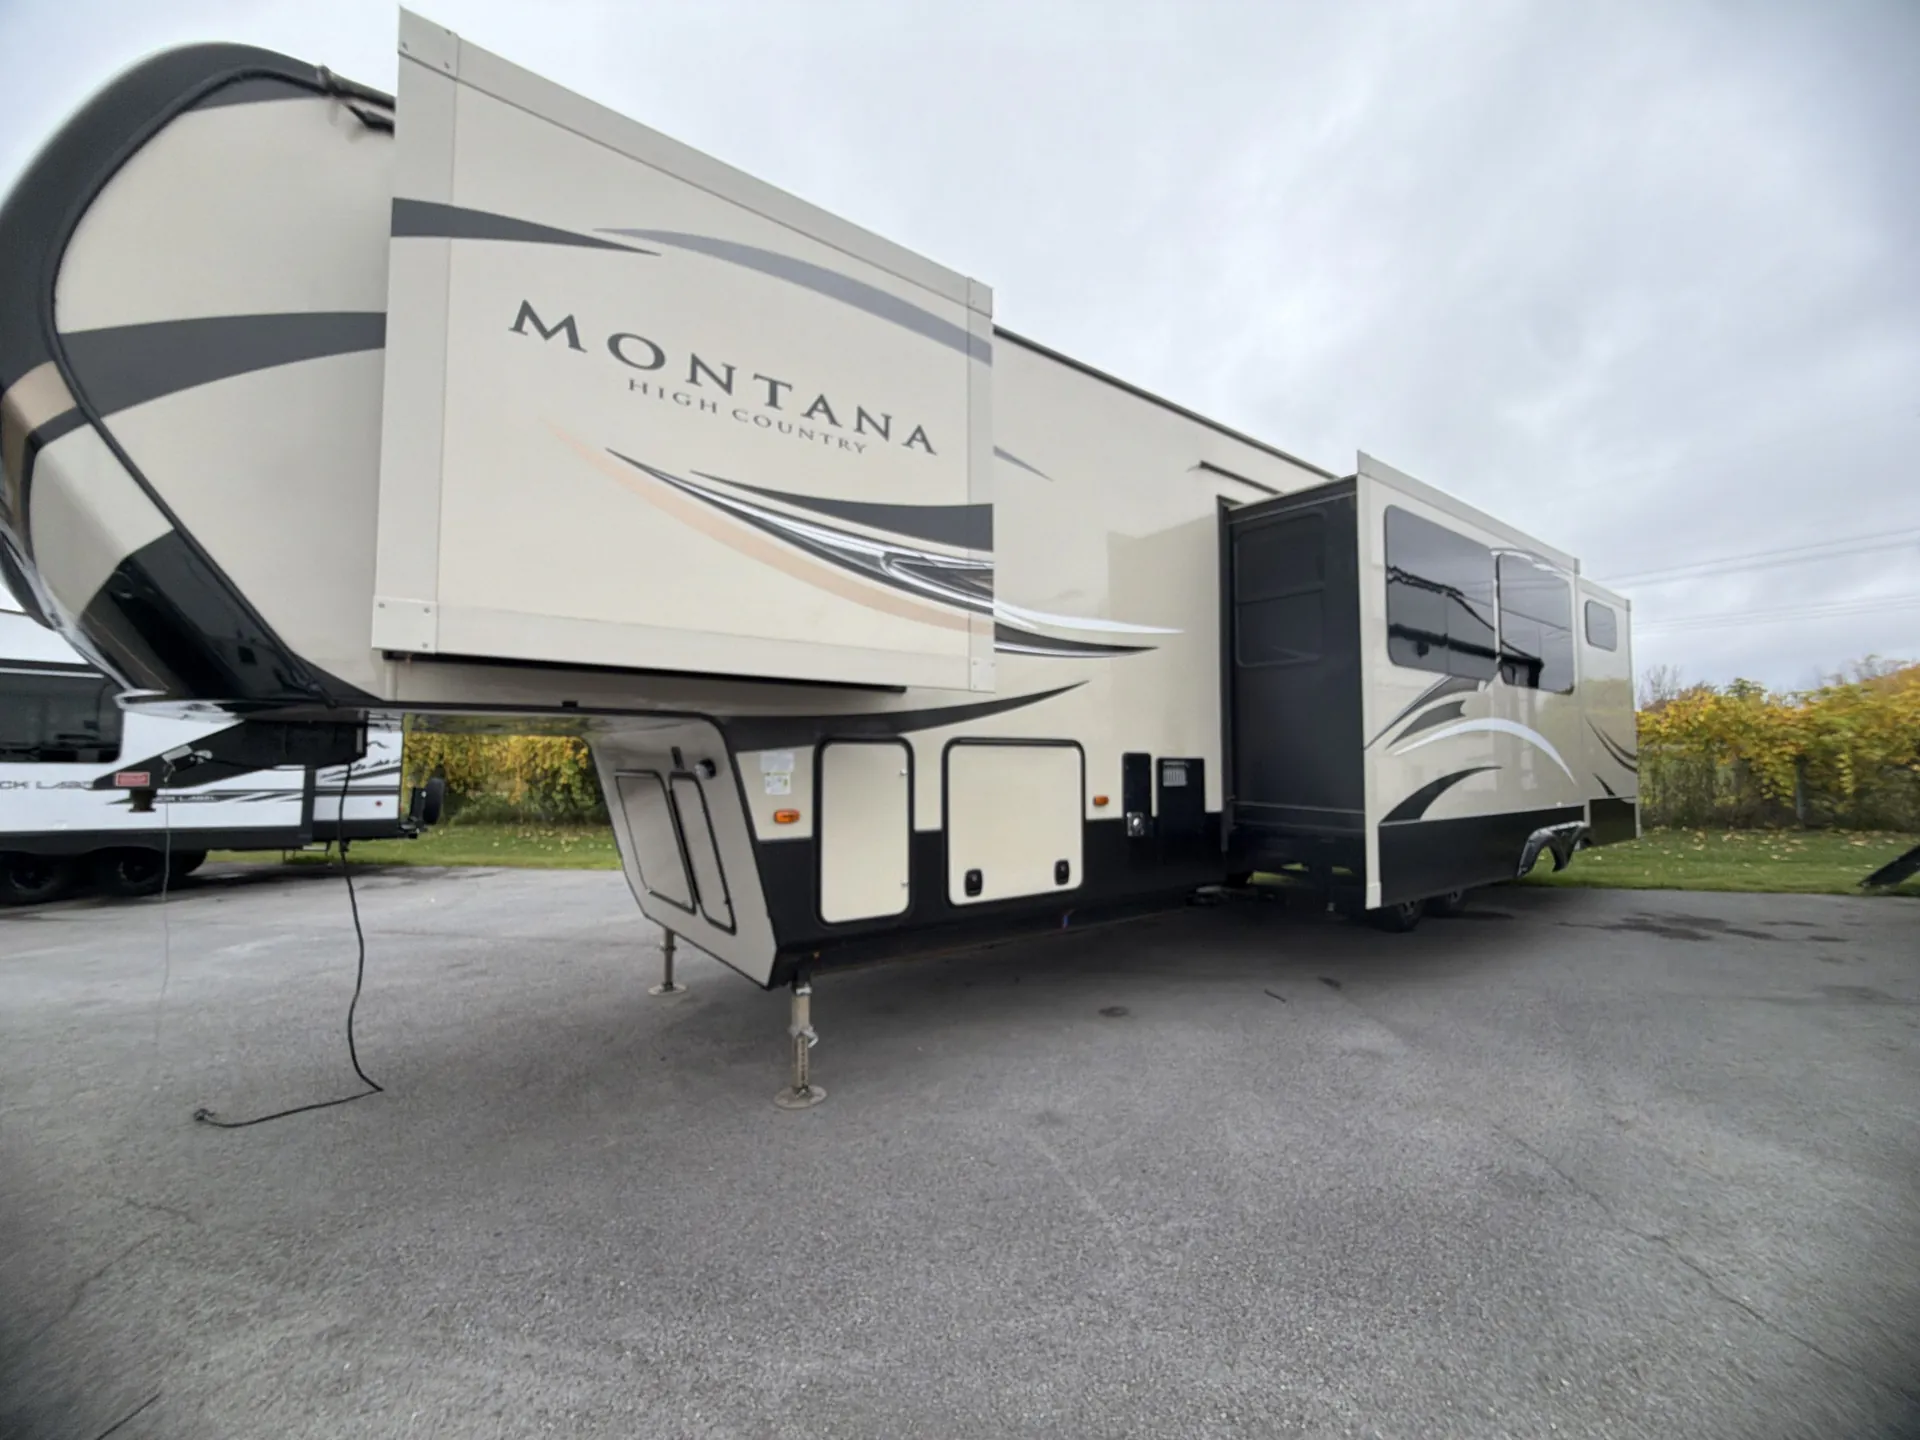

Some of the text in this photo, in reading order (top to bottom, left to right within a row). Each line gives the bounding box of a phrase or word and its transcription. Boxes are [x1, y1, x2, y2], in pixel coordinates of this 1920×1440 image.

[509, 299, 938, 455] MONTANA
[628, 378, 867, 455] HIGH COUNTRY
